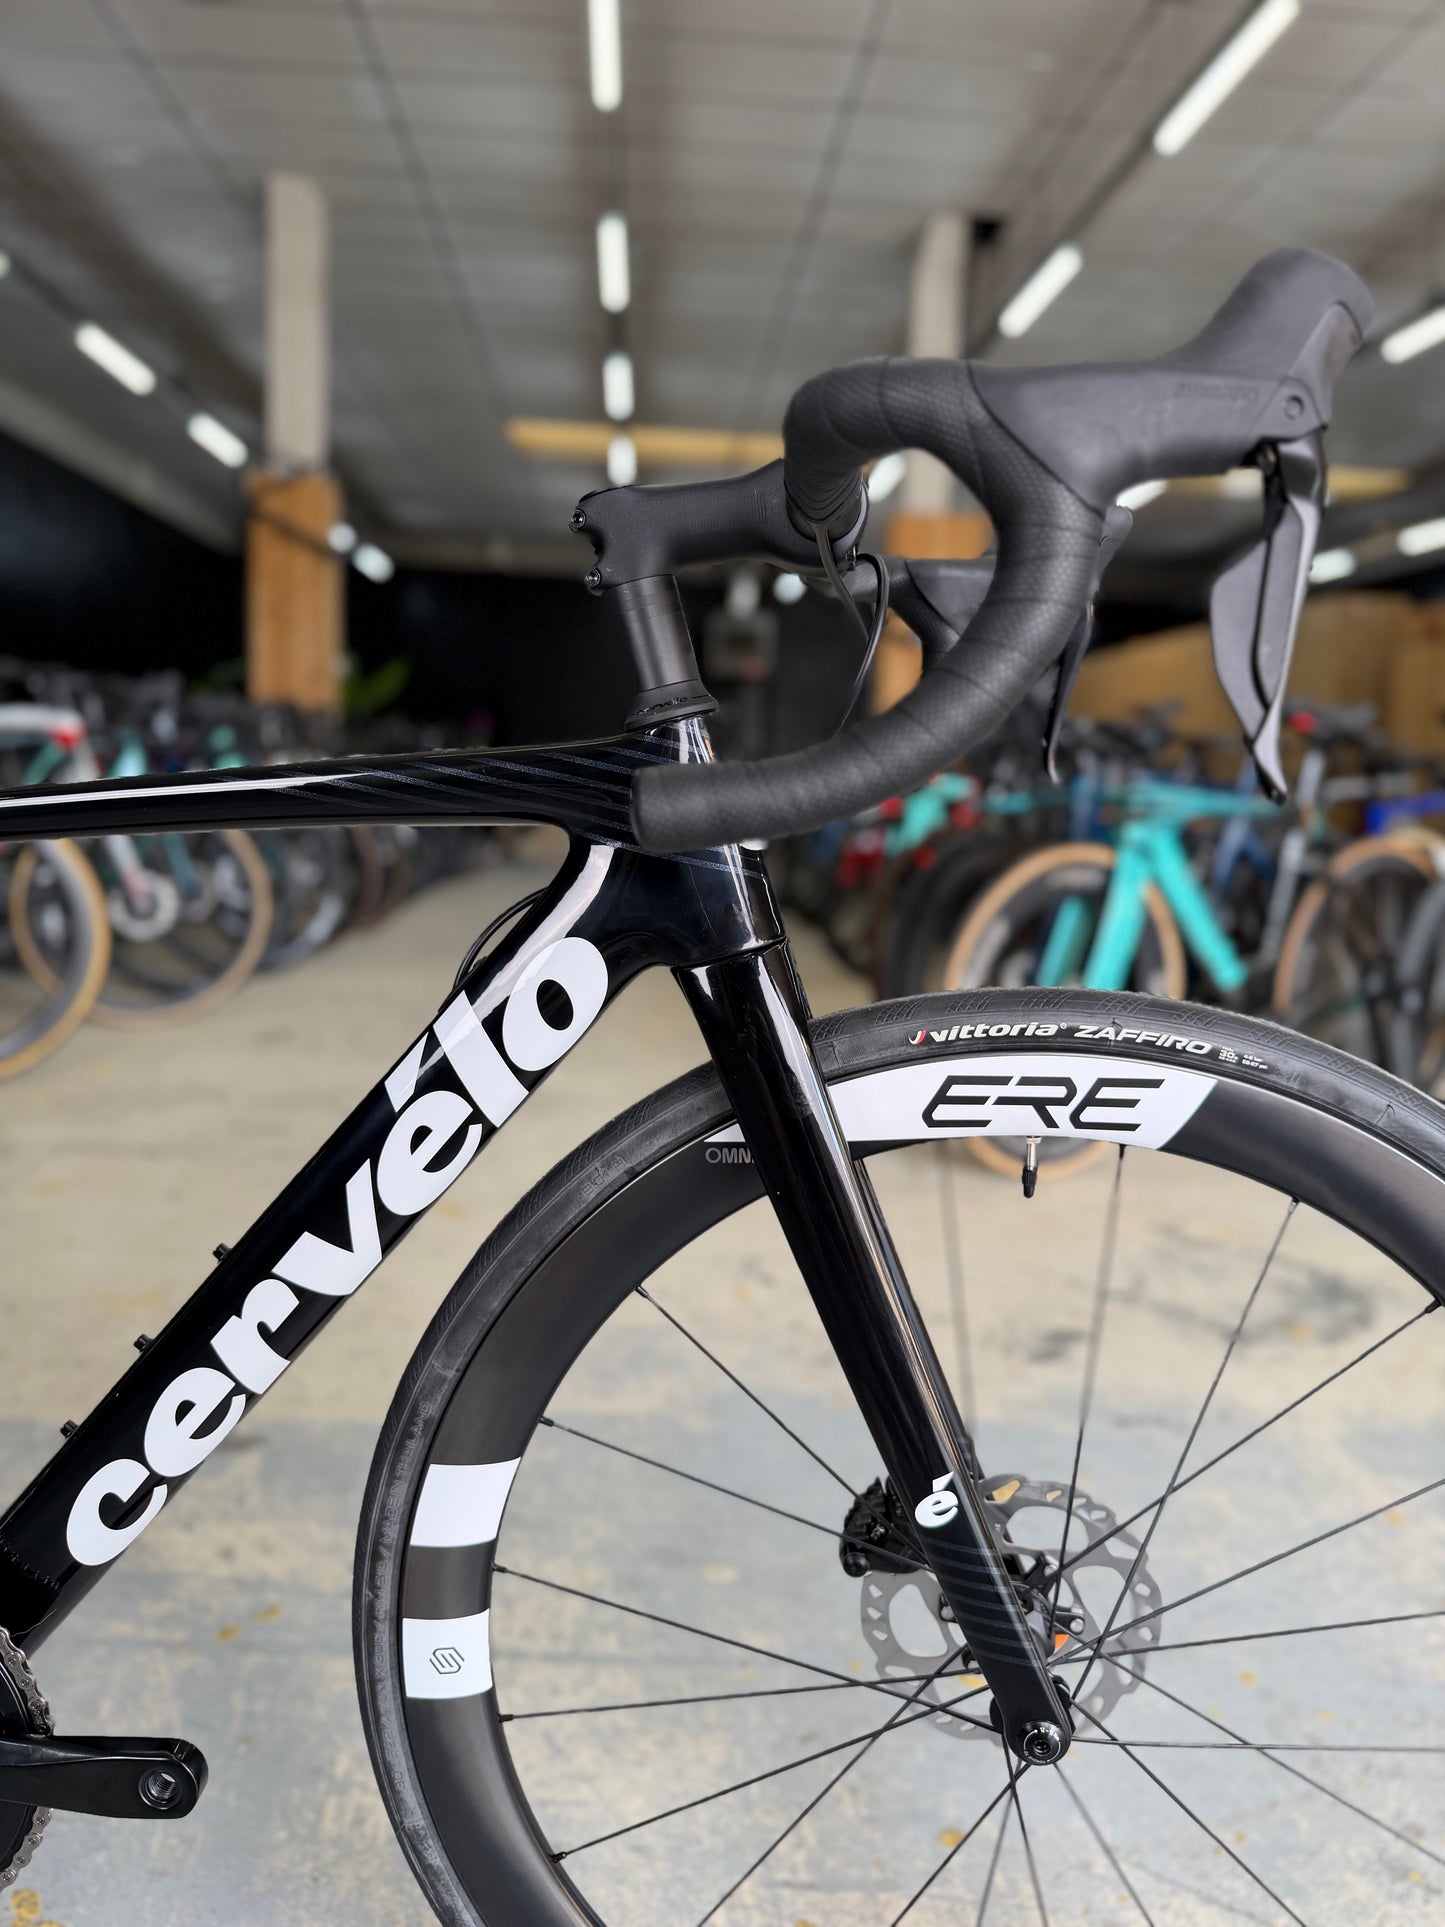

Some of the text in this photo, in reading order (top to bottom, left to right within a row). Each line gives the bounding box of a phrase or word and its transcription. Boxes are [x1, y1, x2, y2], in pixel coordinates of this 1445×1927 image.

[1073, 1025, 1213, 1055] ZAFFIRO
[921, 1075, 1166, 1132] ERE
[705, 1147, 755, 1164] OMN
[66, 937, 609, 1566] cervélo
[914, 1470, 959, 1529] é
